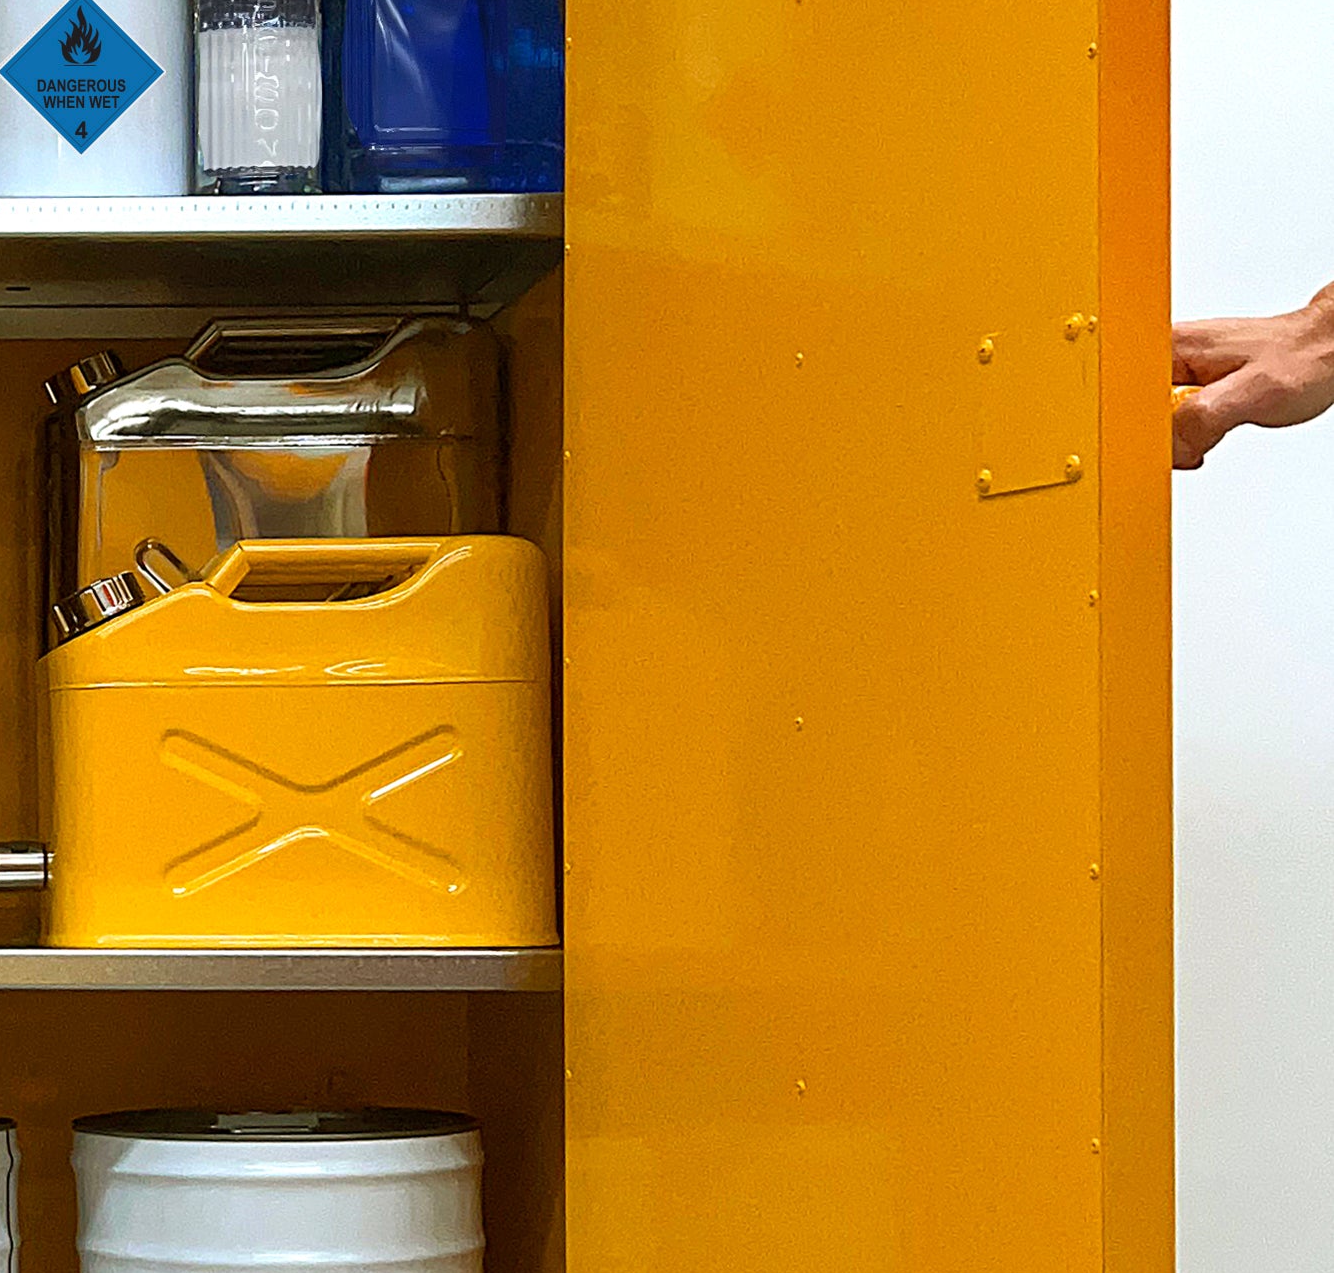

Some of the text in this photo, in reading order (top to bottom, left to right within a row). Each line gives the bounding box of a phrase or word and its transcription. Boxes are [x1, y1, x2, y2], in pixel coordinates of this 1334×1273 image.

[36, 79, 127, 93] DANGEROUS
[42, 95, 120, 109] WHEN WET
[74, 120, 88, 139] 4
